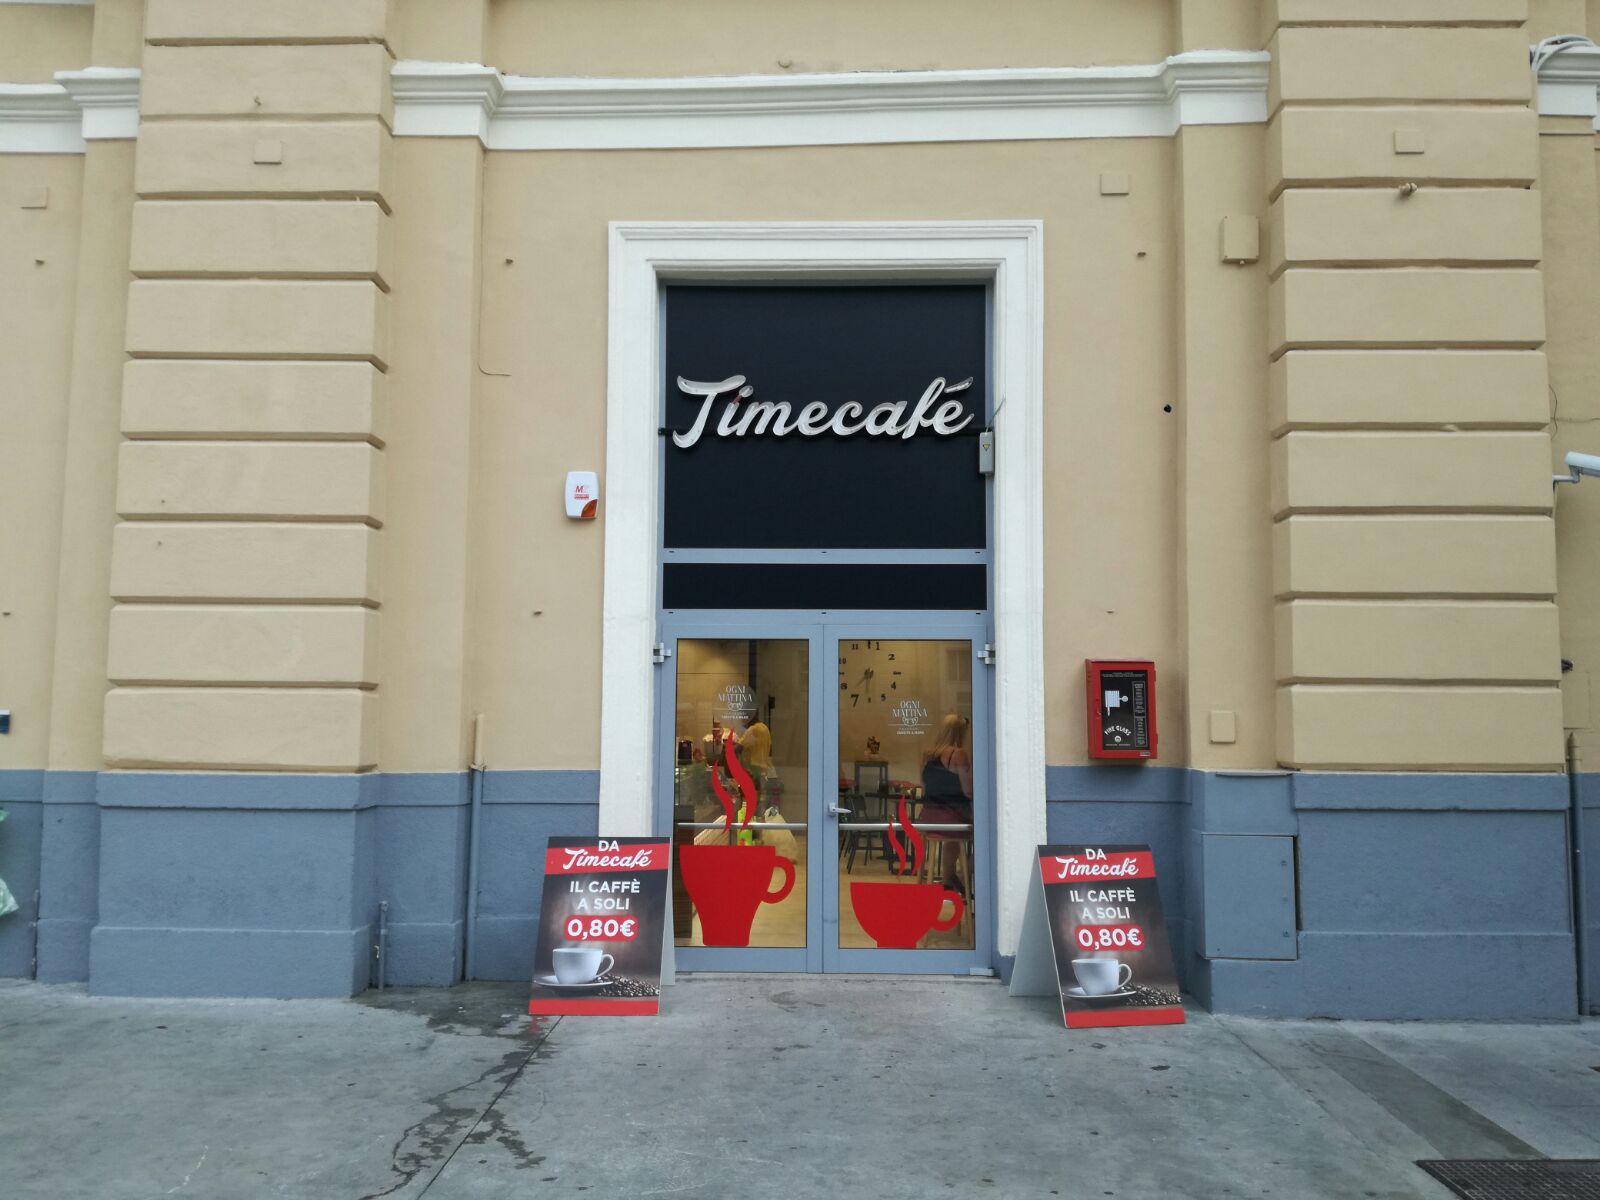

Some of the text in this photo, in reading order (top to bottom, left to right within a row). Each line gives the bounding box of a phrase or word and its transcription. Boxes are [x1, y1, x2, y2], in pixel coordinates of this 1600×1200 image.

[673, 375, 975, 448] Timecafé
[725, 685, 746, 693] OGNI
[851, 694, 859, 707] 7
[900, 700, 920, 708] OGNI
[598, 840, 620, 852] DA
[563, 848, 653, 870] Timecafé
[1085, 848, 1107, 860] DA
[1055, 857, 1139, 879] Timecafé
[569, 878, 641, 893] IL CAFFÈ
[1070, 887, 1136, 902] IL CAFFÈ
[577, 898, 630, 910] A SOLI
[1081, 907, 1130, 919] A SOLI
[567, 918, 635, 940] 0,80€
[1078, 928, 1142, 950] 0,80€
